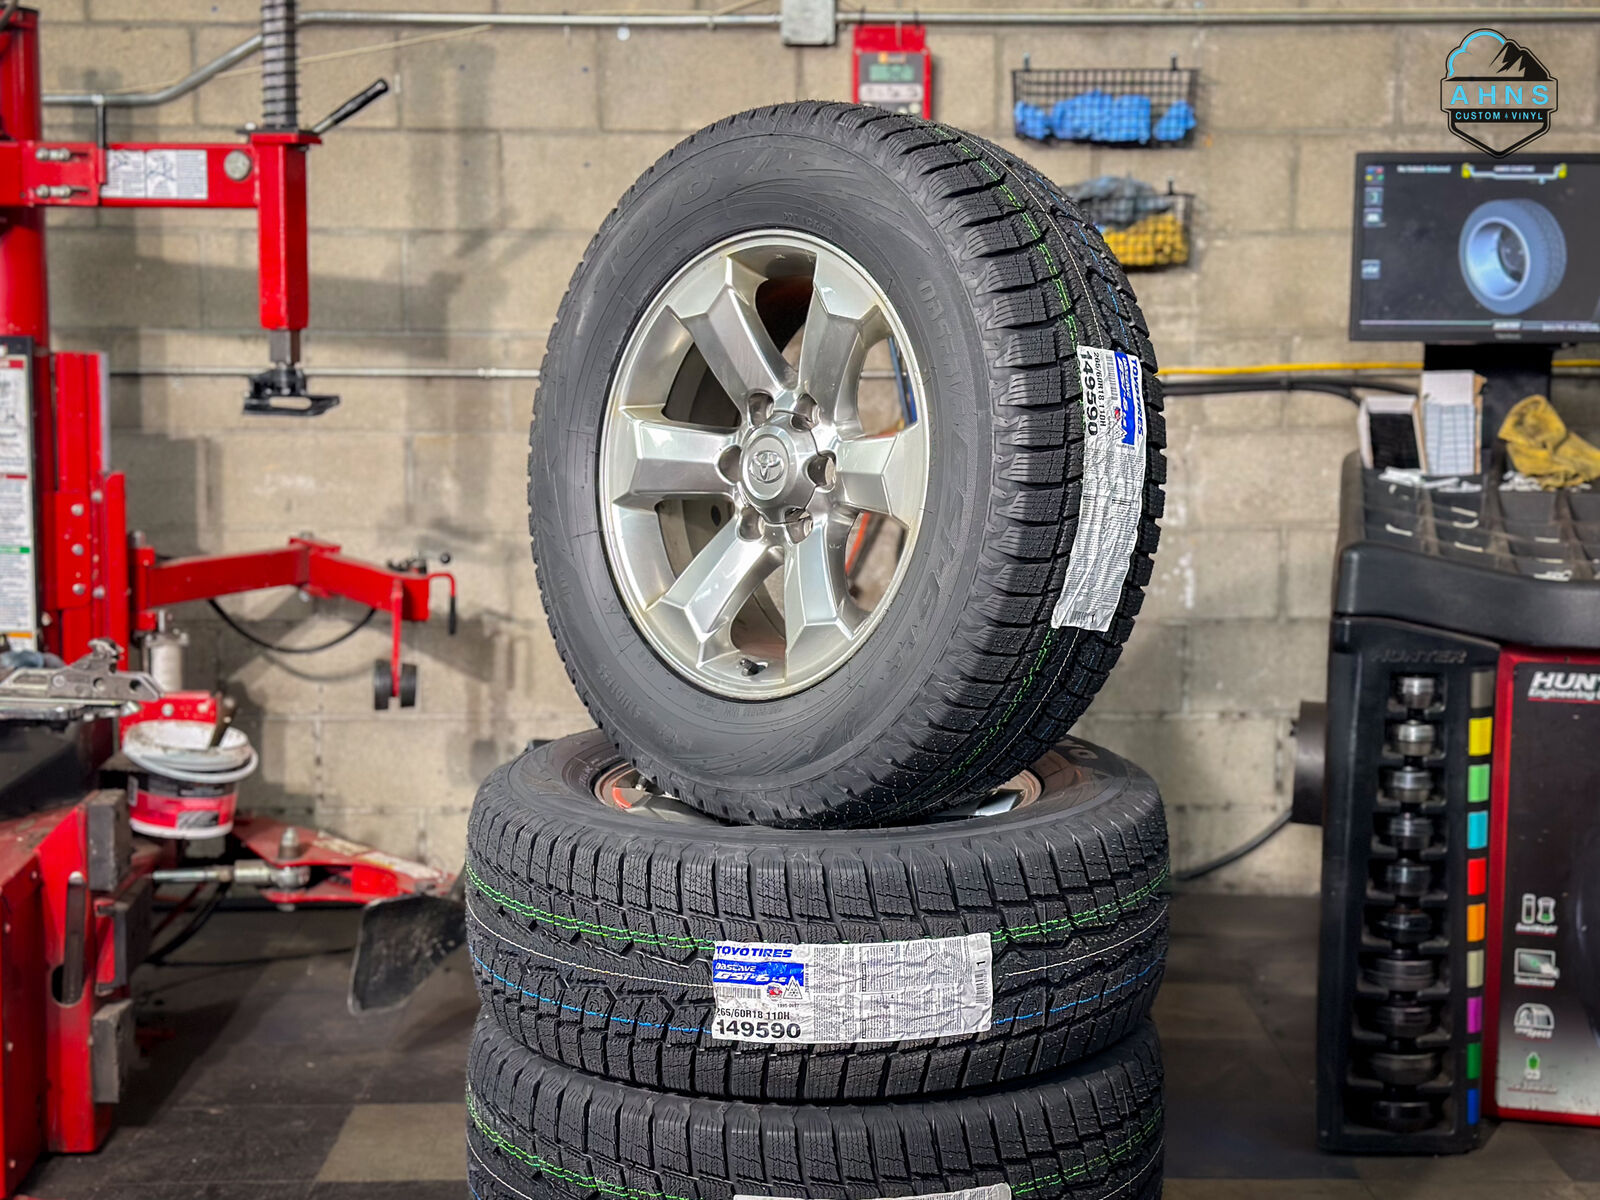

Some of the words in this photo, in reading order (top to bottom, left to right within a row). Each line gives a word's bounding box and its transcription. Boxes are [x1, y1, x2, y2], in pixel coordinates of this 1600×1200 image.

[1094, 351, 1104, 401] 265/60R18
[1131, 359, 1140, 396] TOYO
[1080, 350, 1099, 436] 149590
[1135, 396, 1144, 437] TIRES
[1530, 671, 1600, 690] HUN
[716, 946, 749, 956] TOYO
[751, 948, 793, 958] TIRES
[716, 1008, 763, 1019] 265/60R18
[765, 1012, 790, 1020] 110H
[715, 1019, 801, 1039] 149590
